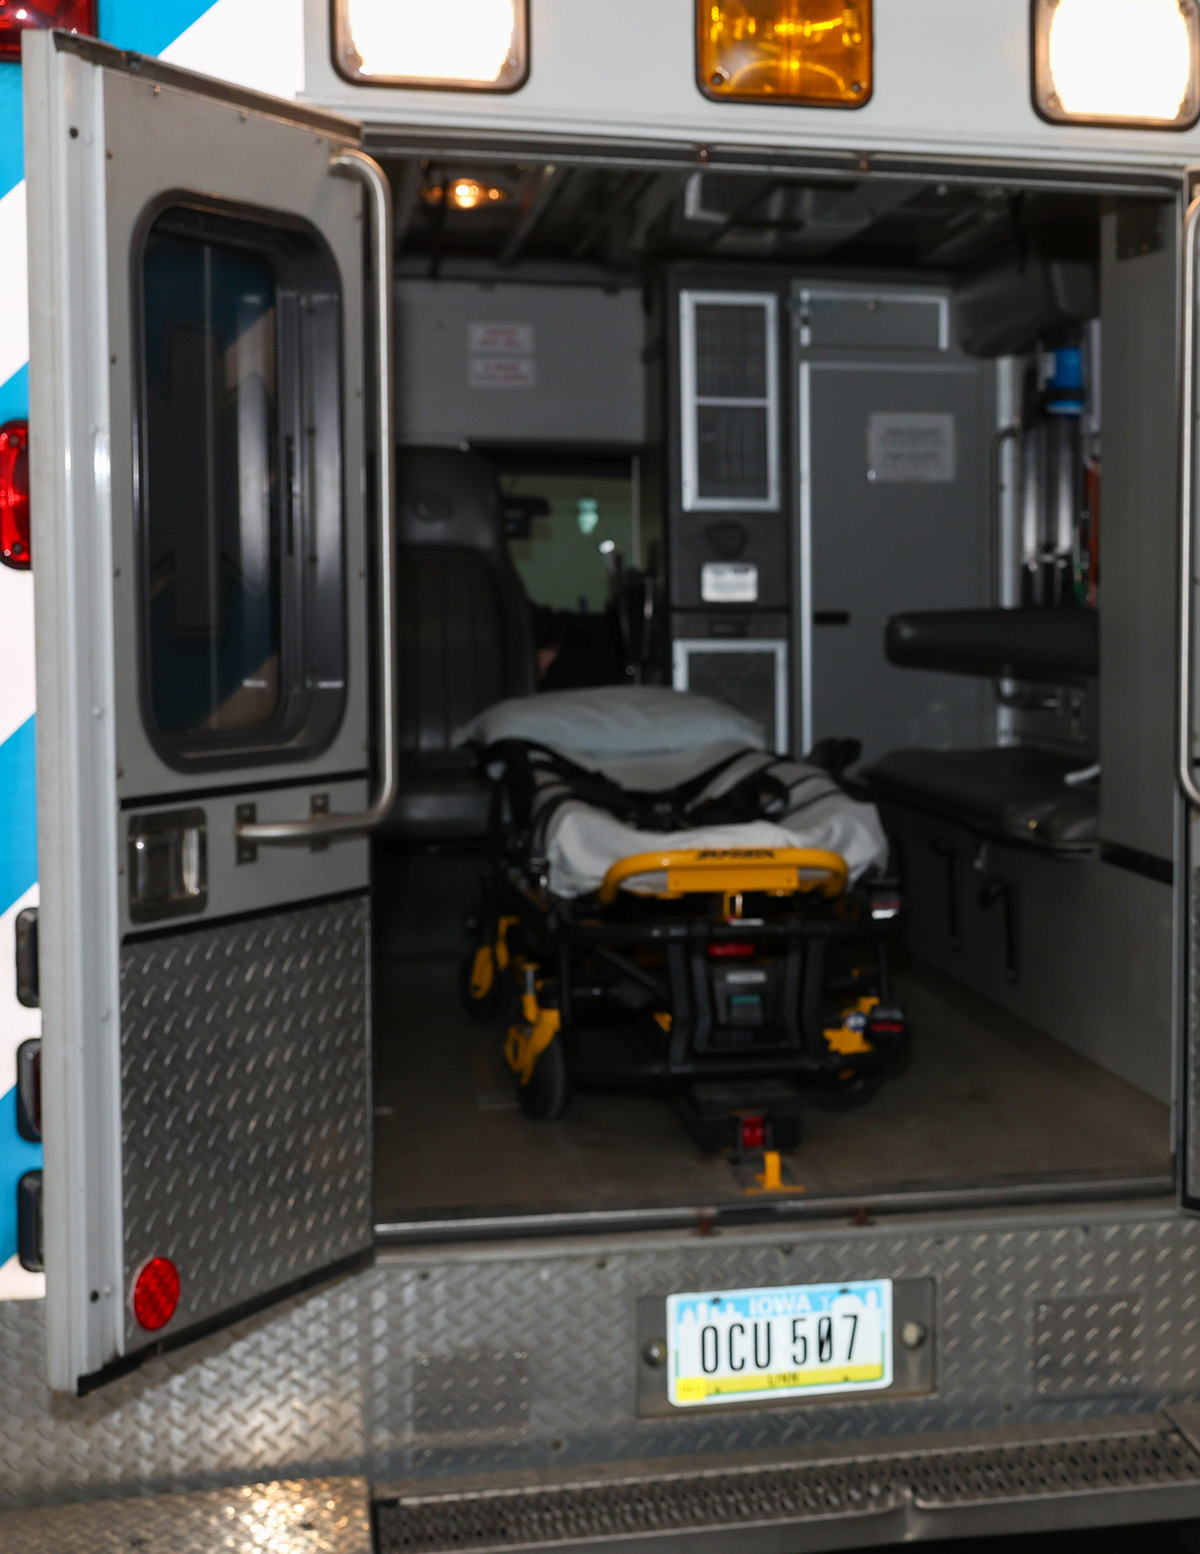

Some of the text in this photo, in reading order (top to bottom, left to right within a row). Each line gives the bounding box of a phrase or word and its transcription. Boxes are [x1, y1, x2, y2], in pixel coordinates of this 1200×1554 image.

[750, 1294, 812, 1317] IOWA
[701, 1314, 858, 1374] OCU 507
